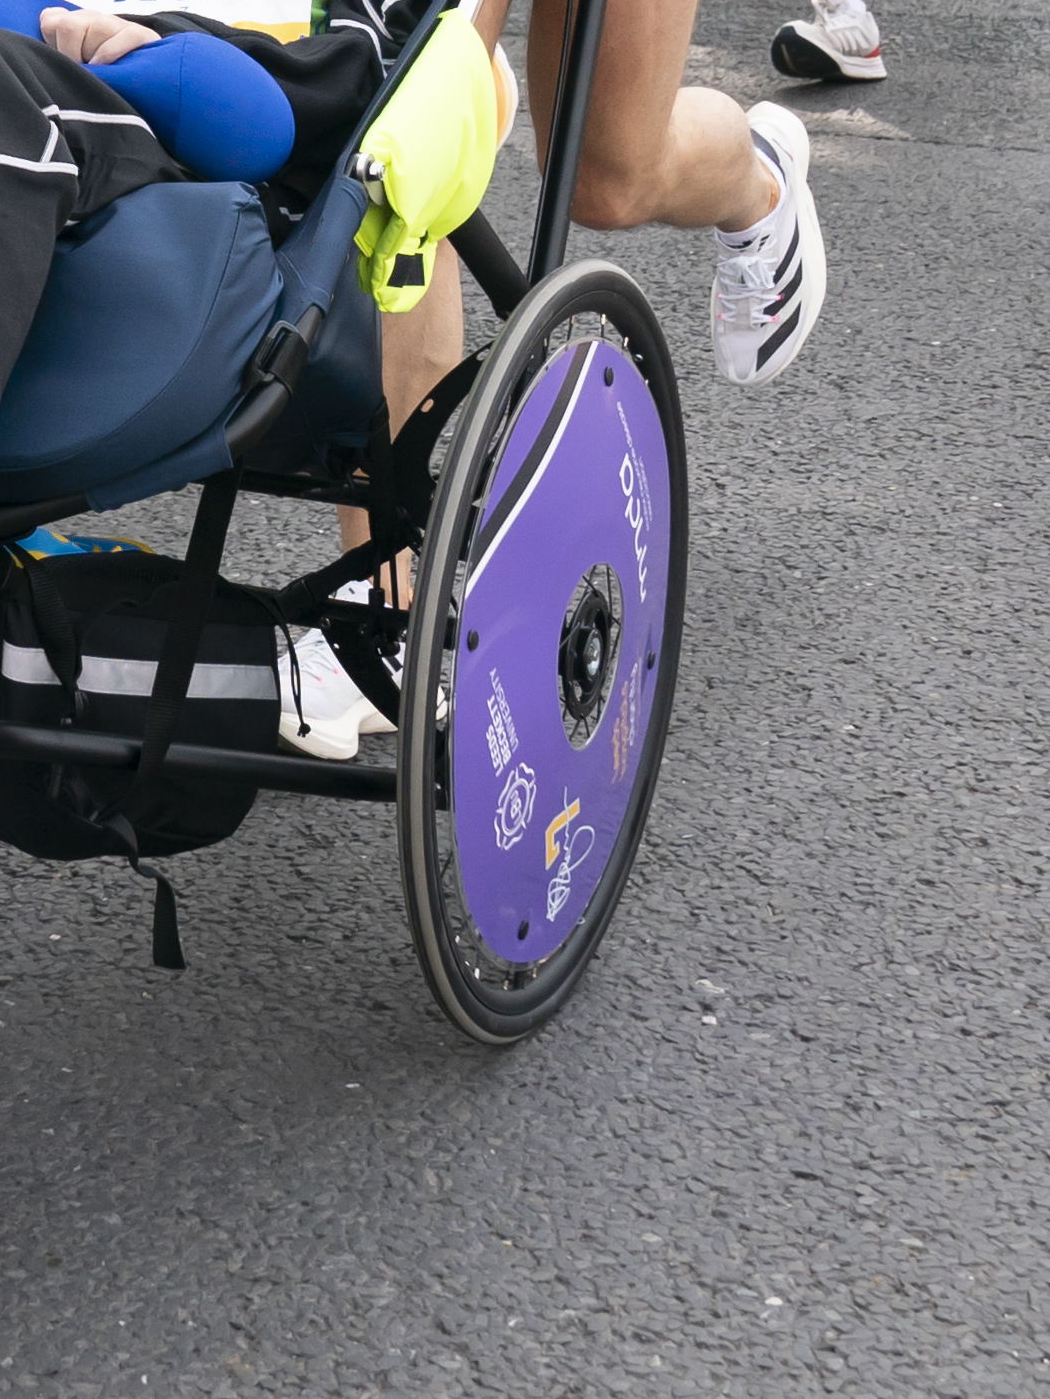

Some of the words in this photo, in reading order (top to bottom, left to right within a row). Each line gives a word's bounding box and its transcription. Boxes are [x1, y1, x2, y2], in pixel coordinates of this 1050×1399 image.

[618, 452, 648, 604] mnda
[487, 694, 512, 765] BECKETT
[489, 667, 520, 754] UNIVERSITY
[485, 723, 504, 778] LEEDS
